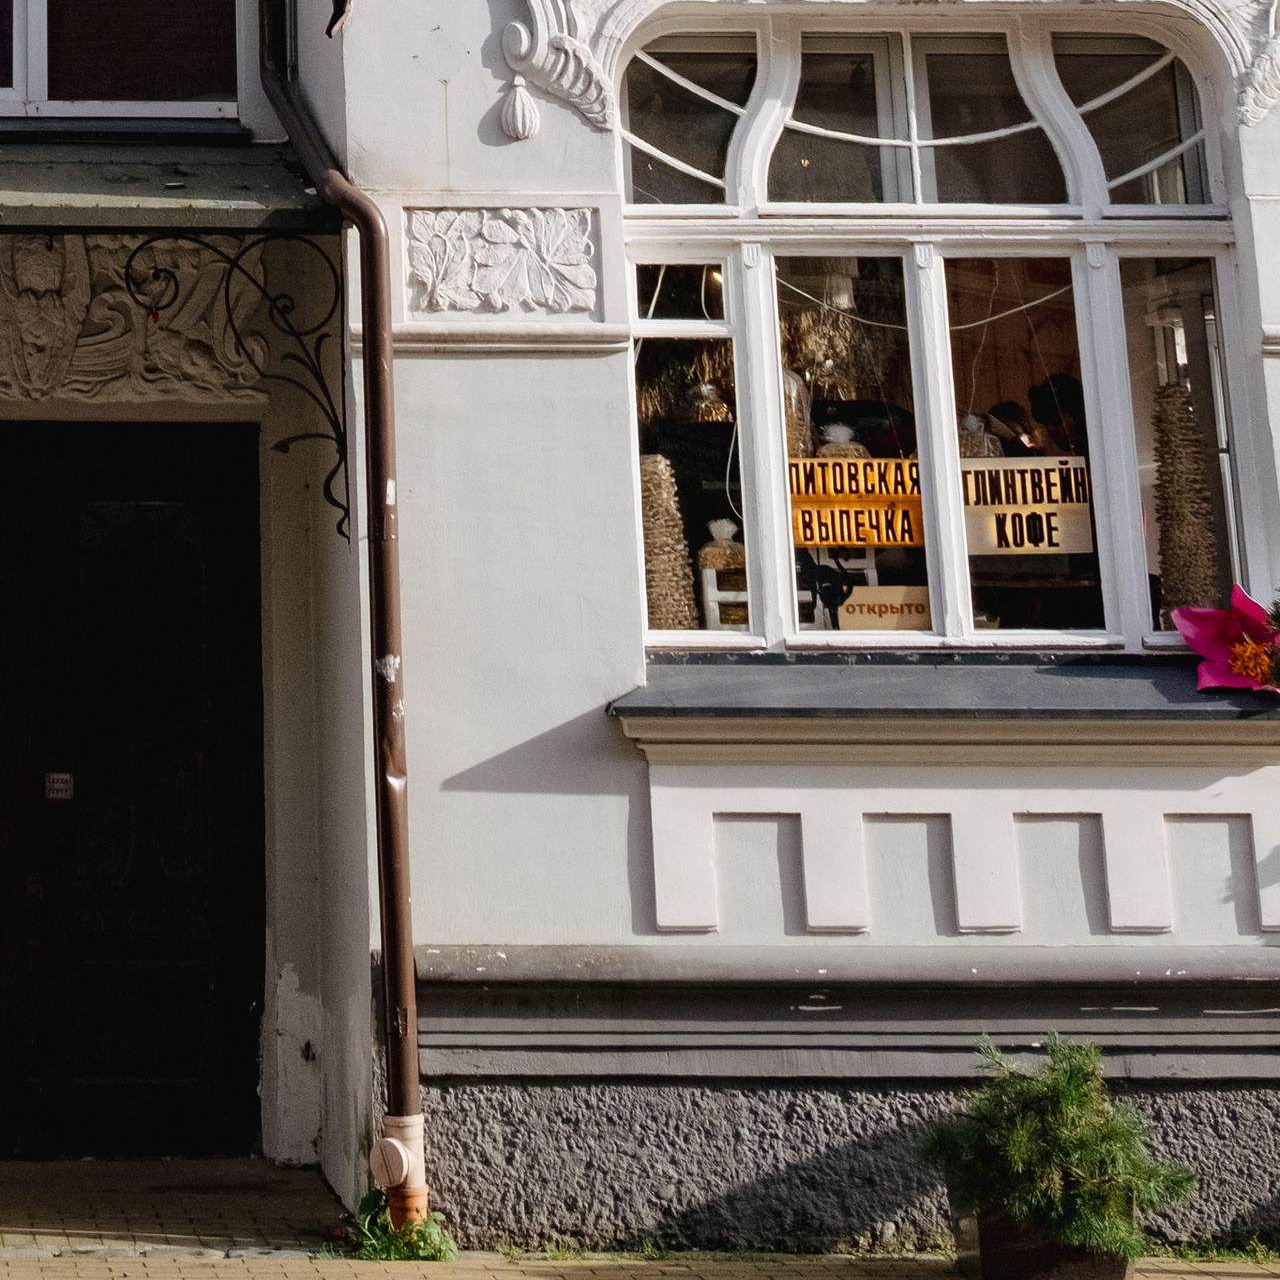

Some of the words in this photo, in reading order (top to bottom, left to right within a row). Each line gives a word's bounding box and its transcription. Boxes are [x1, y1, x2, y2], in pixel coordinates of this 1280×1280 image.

[962, 460, 1088, 506] ГЛИНТВЕЙН
[801, 509, 914, 542] ВЫПЕЧКА
[995, 511, 1060, 548] КОФЕ
[845, 602, 926, 618] открыто
